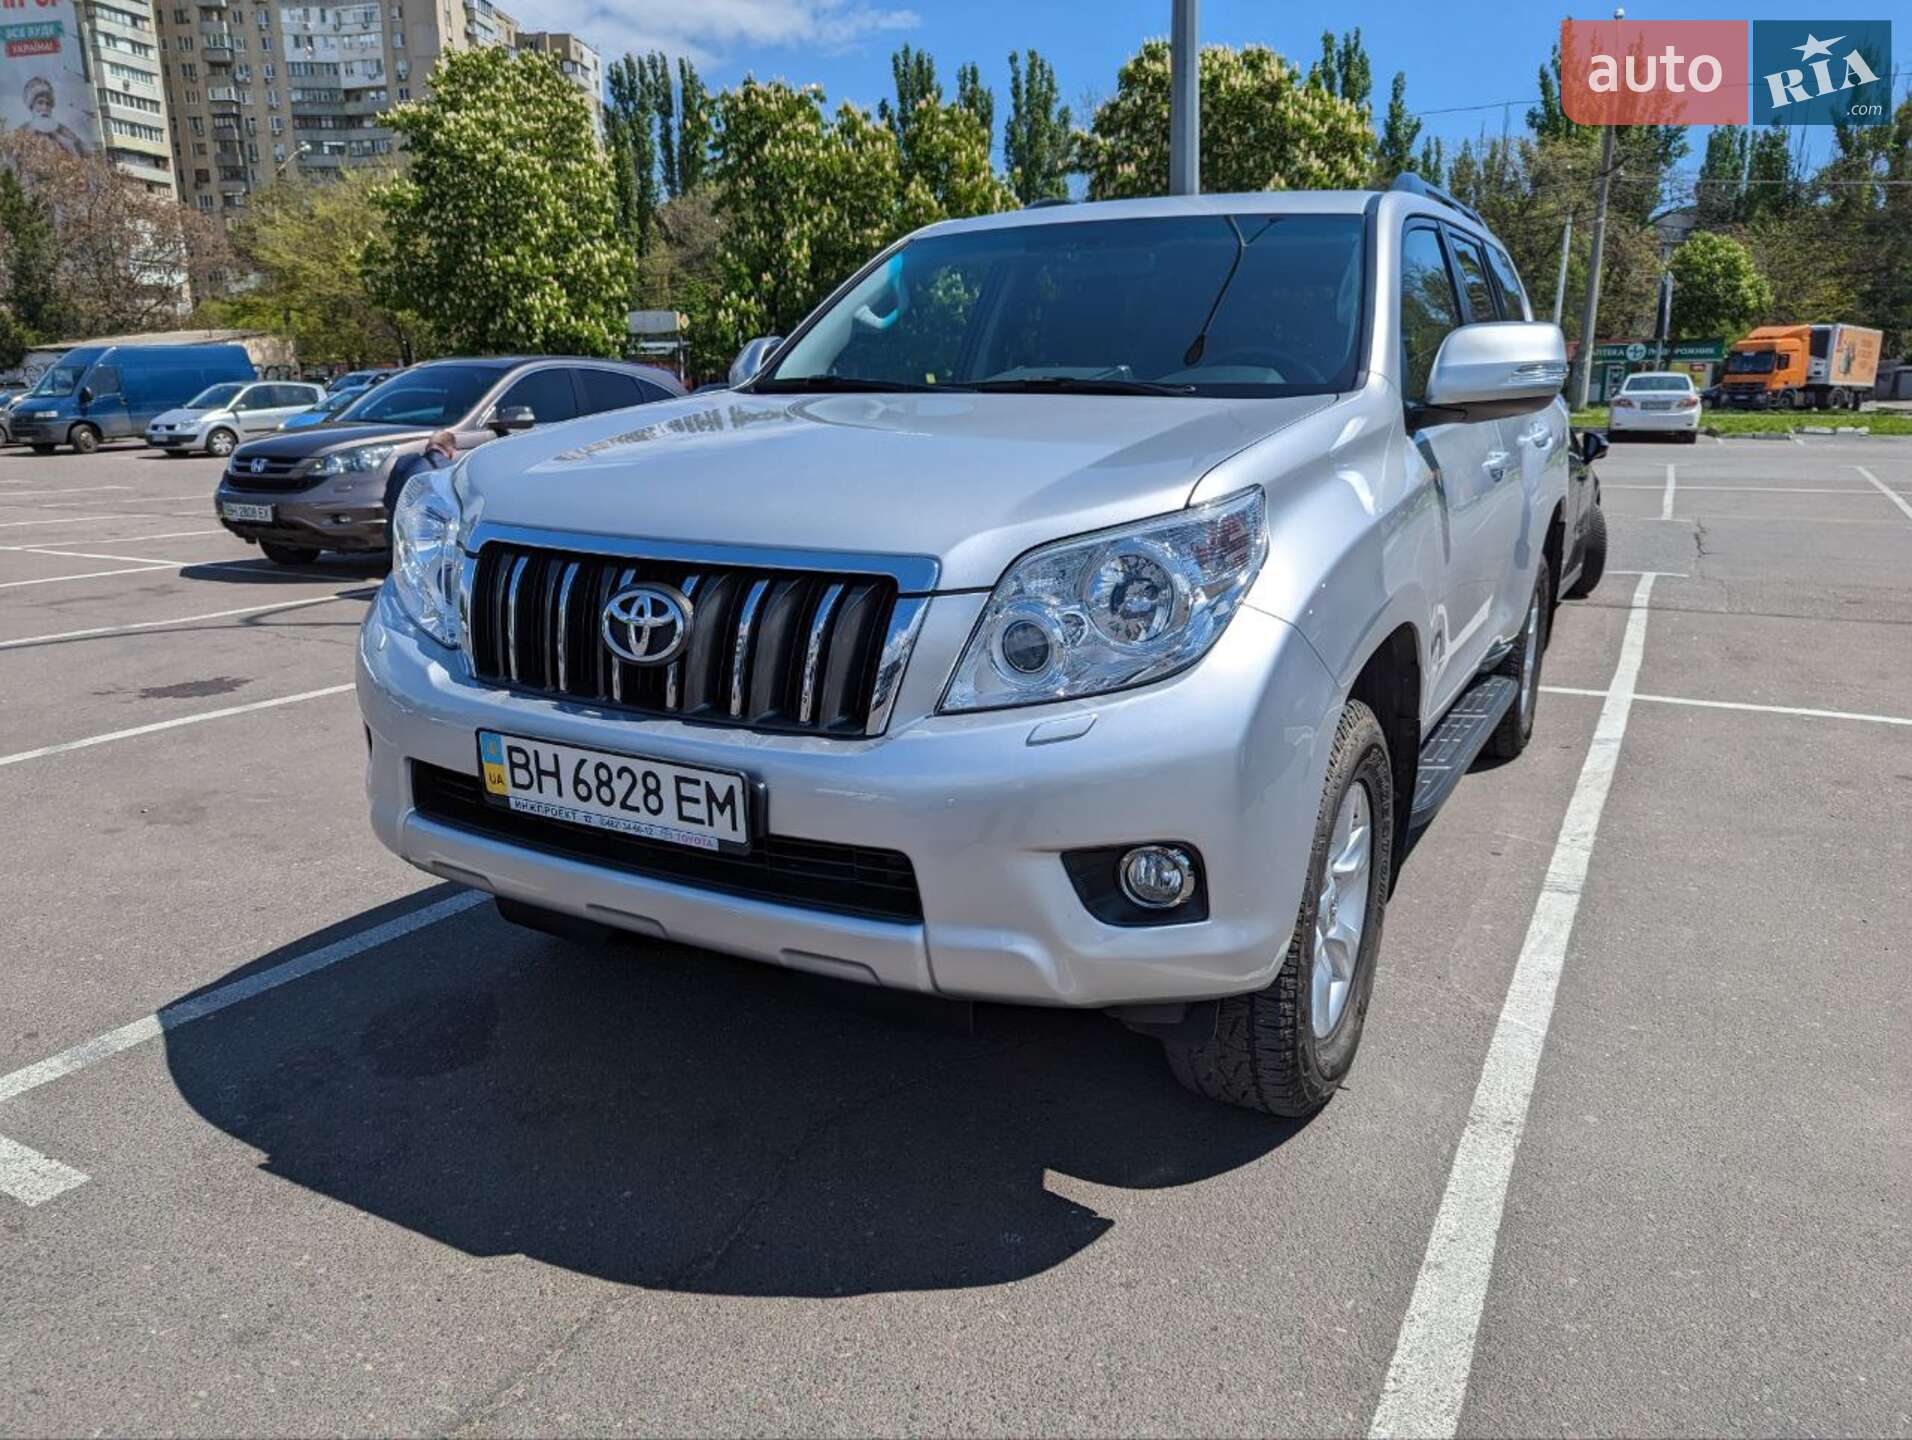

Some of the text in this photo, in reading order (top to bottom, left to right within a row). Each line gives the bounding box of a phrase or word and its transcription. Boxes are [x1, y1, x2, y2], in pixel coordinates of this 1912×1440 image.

[488, 772, 505, 786] UA
[507, 745, 739, 832] BH 6828 EM
[677, 832, 713, 847] TOYOTA
